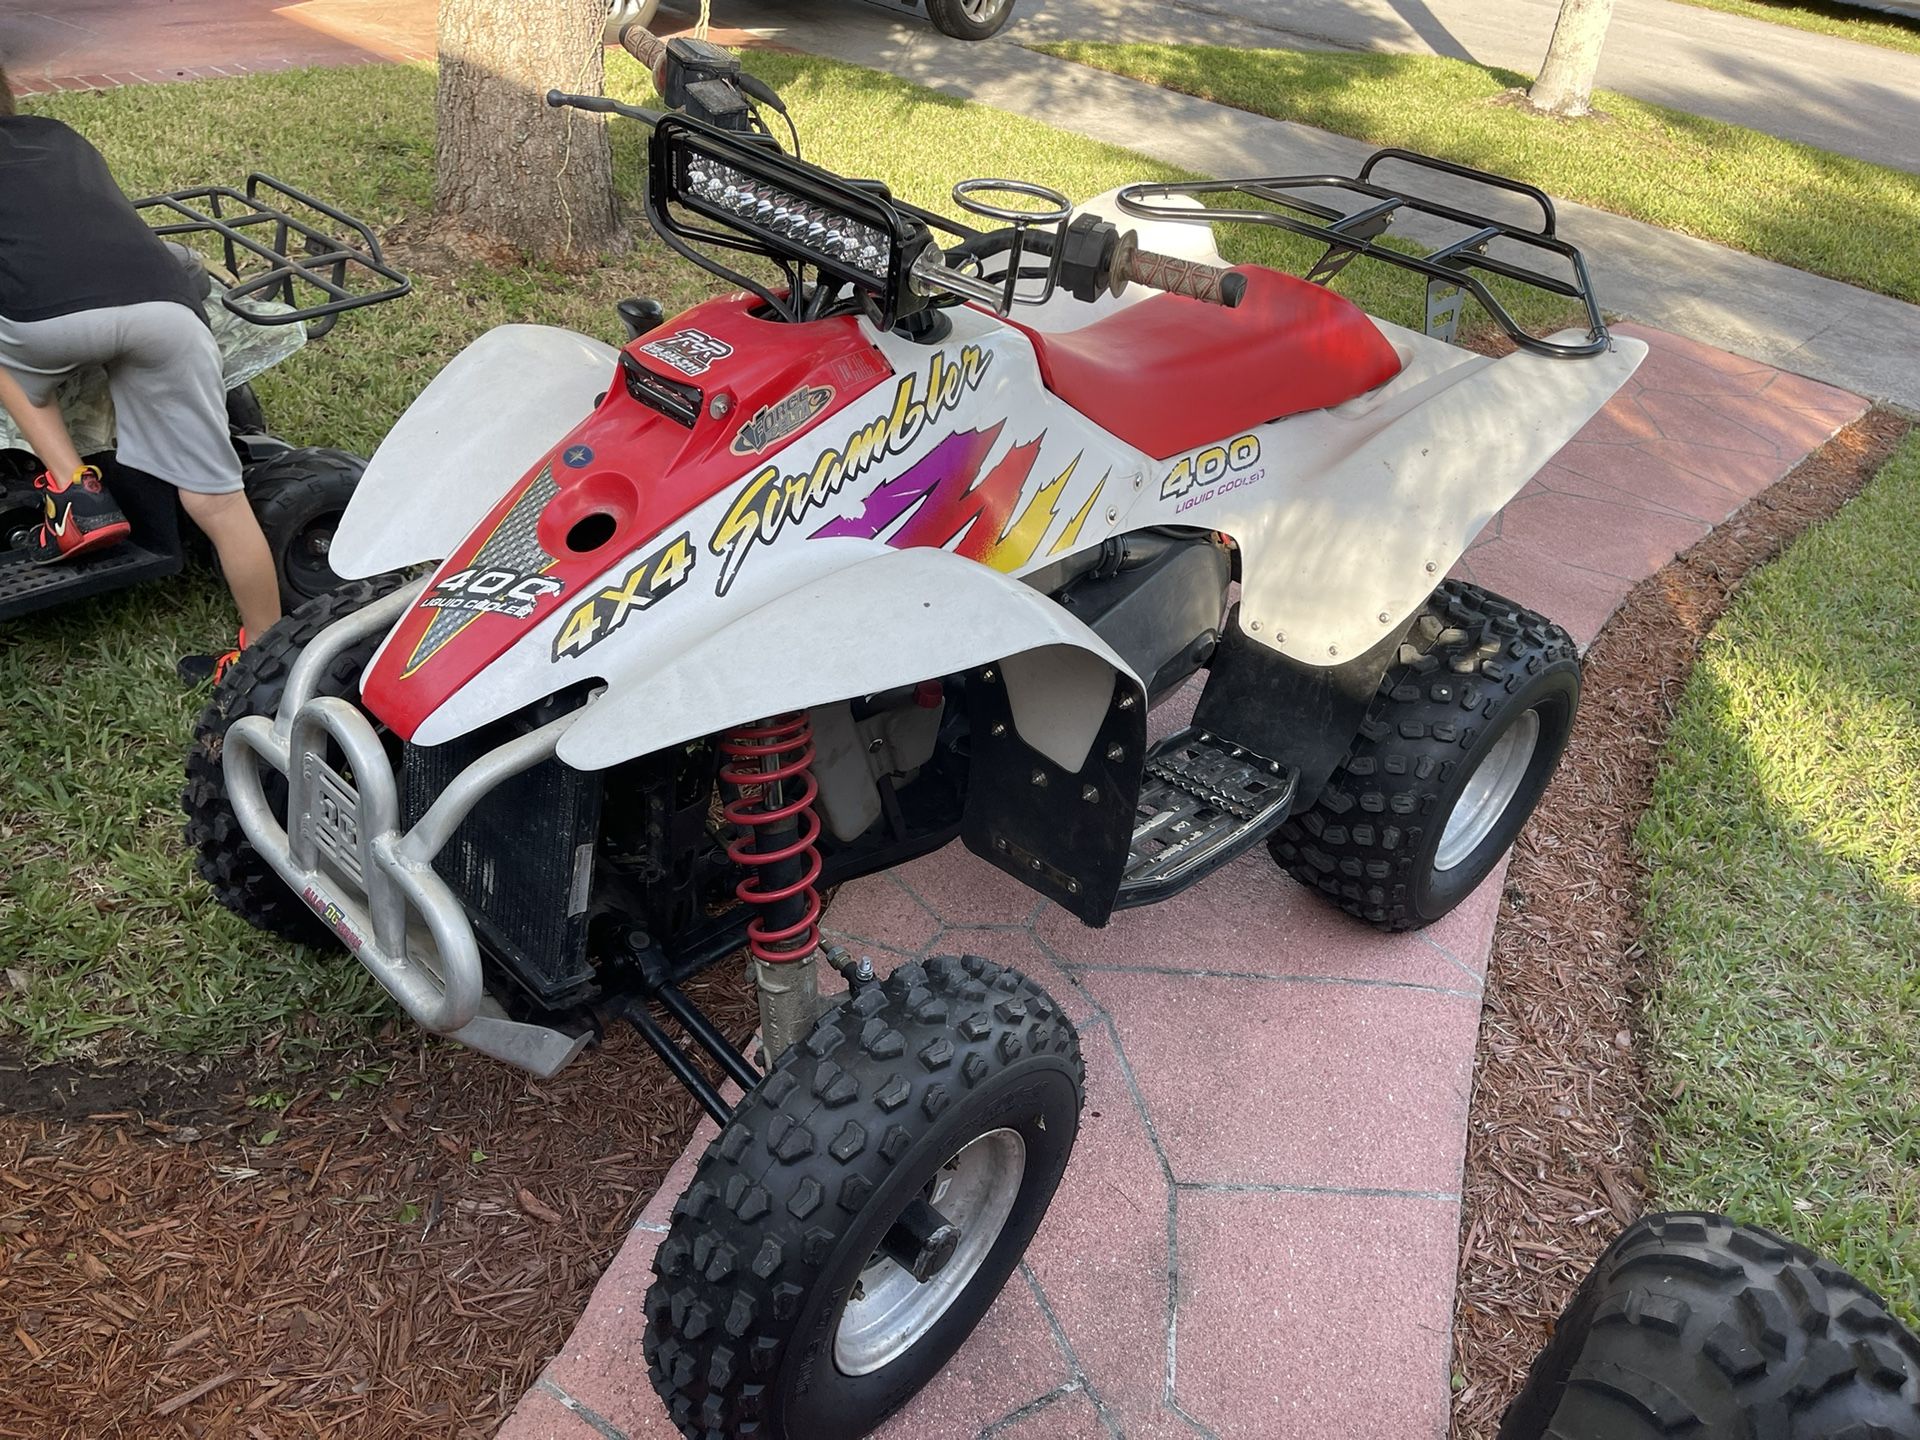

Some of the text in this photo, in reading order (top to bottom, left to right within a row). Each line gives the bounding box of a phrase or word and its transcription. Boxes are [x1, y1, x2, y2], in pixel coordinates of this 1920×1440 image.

[708, 345, 993, 598] Scrambler
[1160, 434, 1261, 501] 400
[1175, 488, 1214, 514] LIQUID
[419, 597, 465, 608] LIQUID
[552, 531, 696, 663] 4X4
